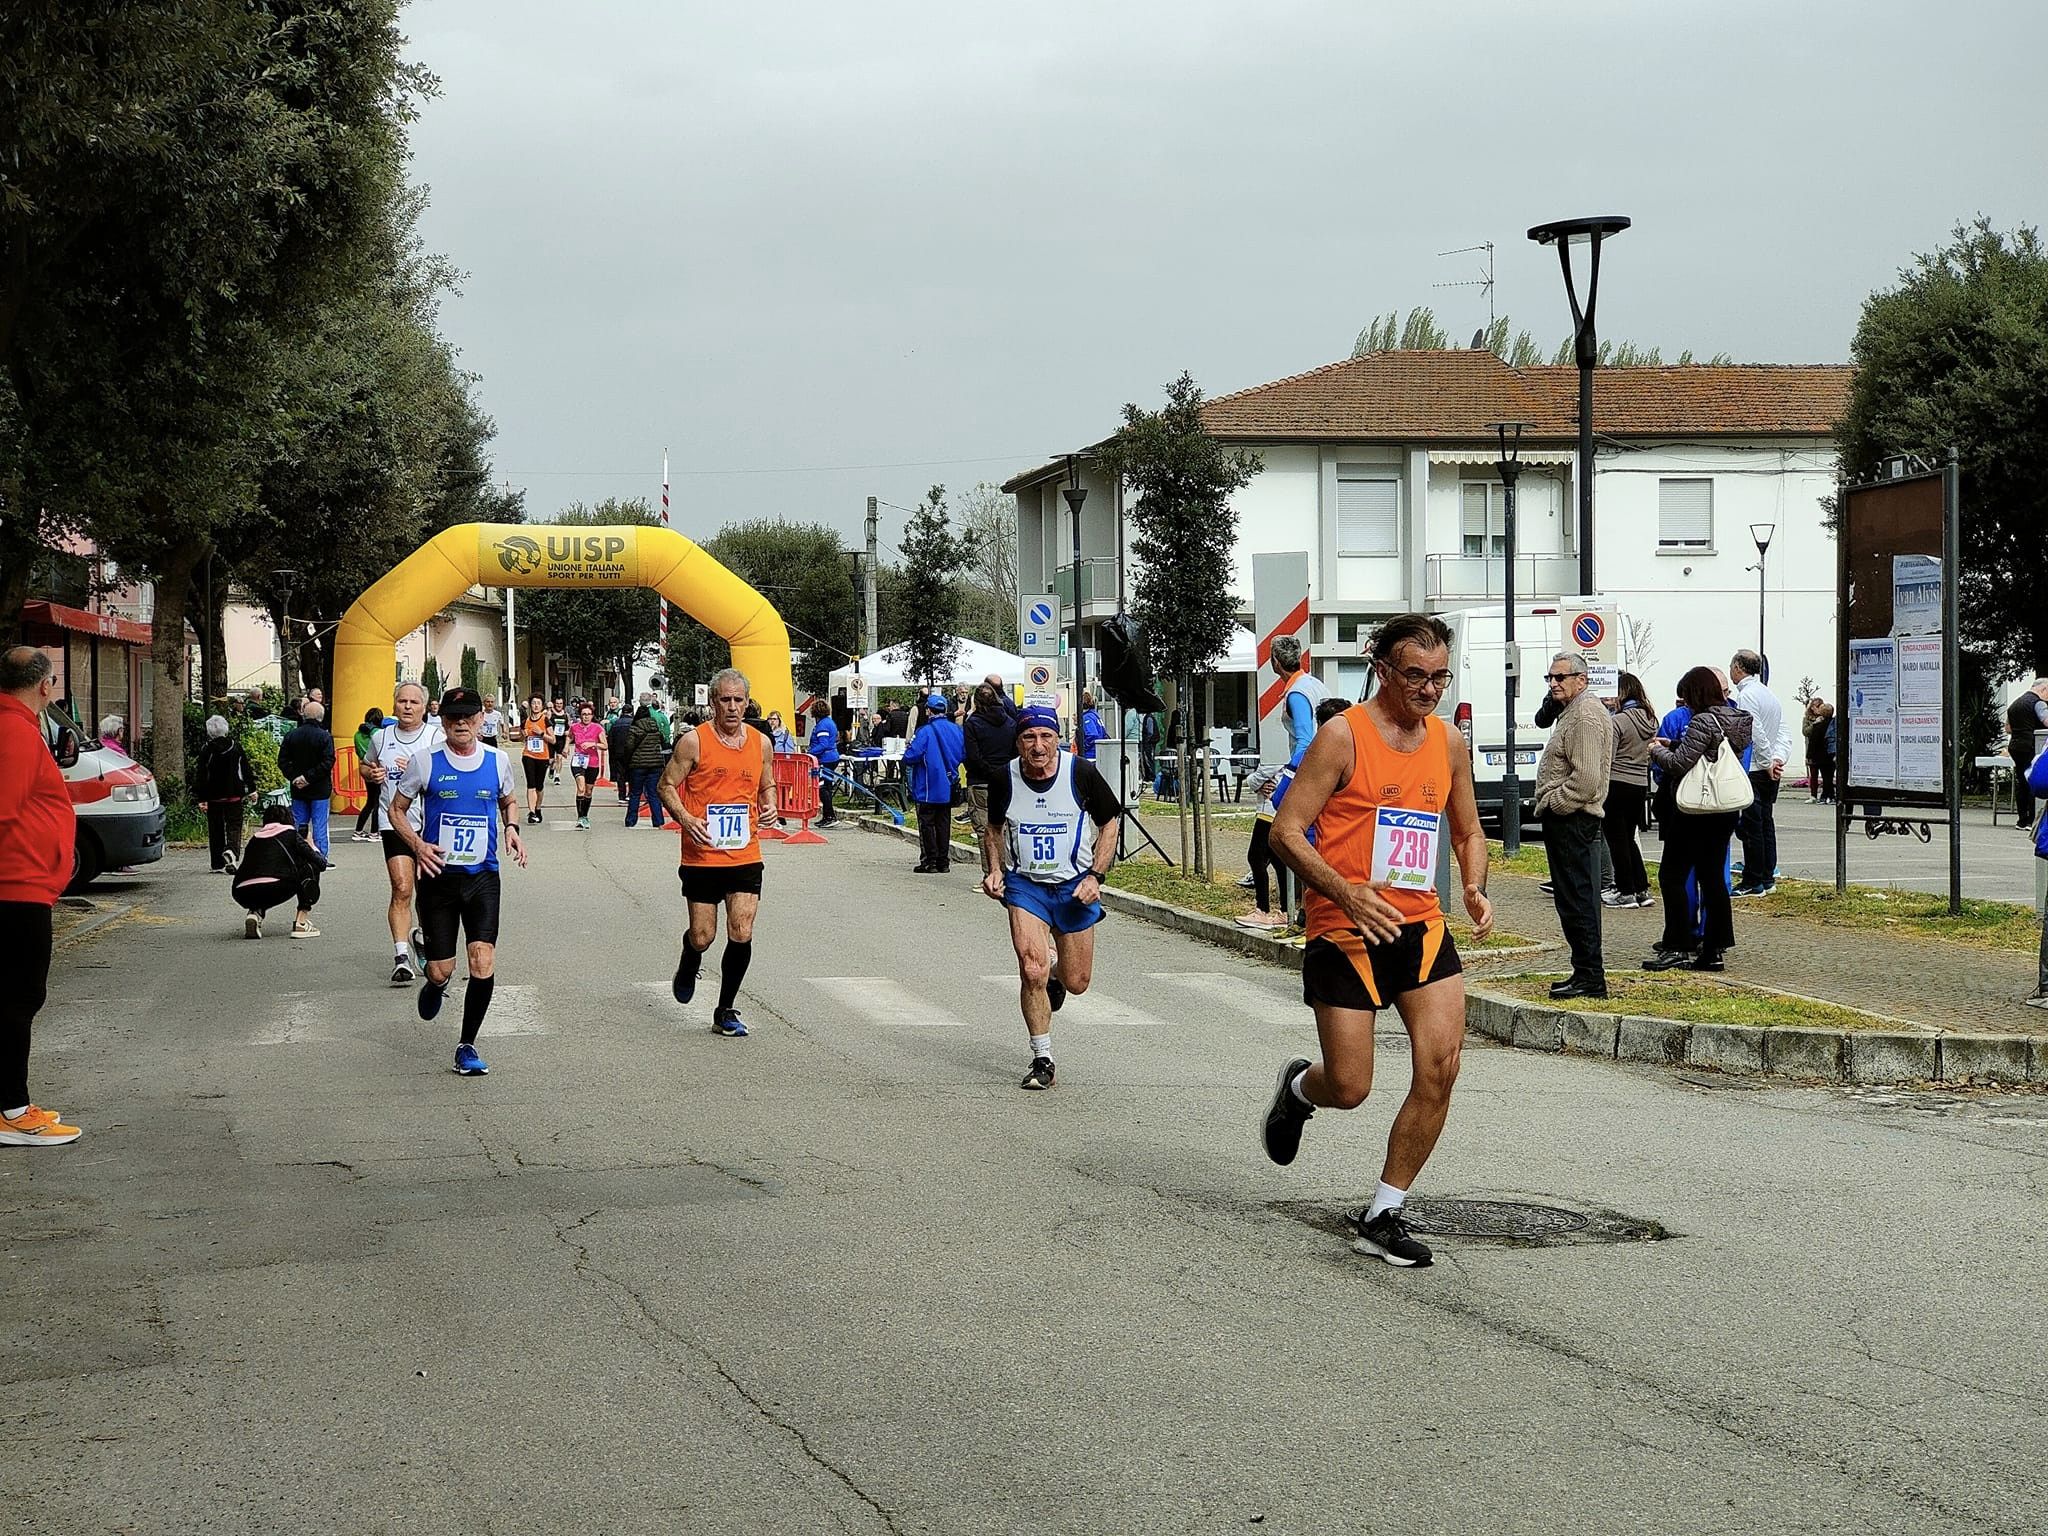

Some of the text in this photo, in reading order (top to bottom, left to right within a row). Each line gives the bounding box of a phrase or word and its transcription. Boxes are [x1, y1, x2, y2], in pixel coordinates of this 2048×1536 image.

[547, 536, 625, 562] UISP
[547, 563, 625, 571] UNIONE ITALIANA
[1896, 583, 1940, 605] Ivan Alvisi
[1859, 649, 1879, 665] Anselmo
[1918, 661, 1940, 671] NATALIA
[1855, 718, 1892, 726] RINGRAZIAMENTO
[1855, 733, 1892, 744] ALVISI IVAN
[1900, 735, 1940, 744] TURCHI ANSELMO
[718, 815, 742, 838] 174
[453, 828, 476, 852] 52
[1033, 836, 1056, 861] 53
[1387, 829, 1430, 870] 238
